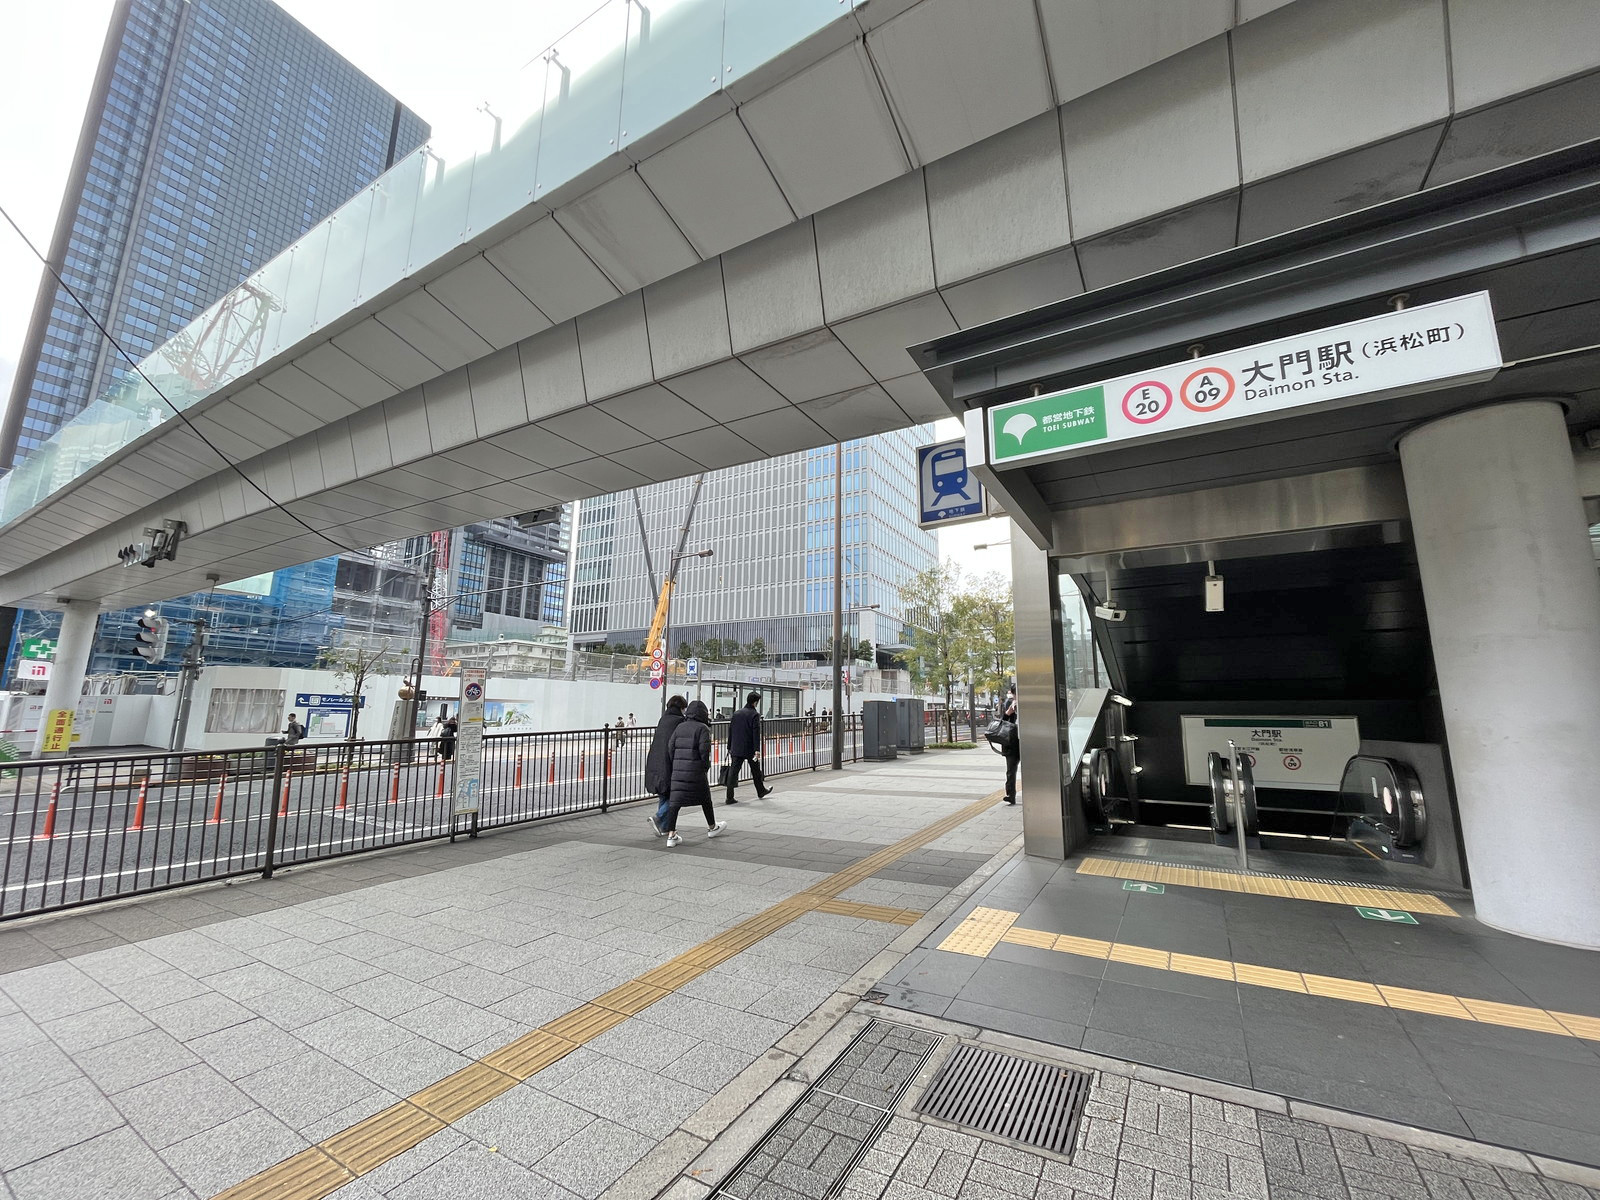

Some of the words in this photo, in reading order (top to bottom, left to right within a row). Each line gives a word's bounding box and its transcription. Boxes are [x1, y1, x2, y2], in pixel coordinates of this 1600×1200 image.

[1241, 341, 1355, 387] 大門駅
[1200, 375, 1213, 388] A
[1244, 379, 1316, 400] Daimon
[1322, 370, 1360, 386] Sta.
[1141, 388, 1150, 400] E
[1194, 387, 1220, 403] 09
[1042, 406, 1095, 425] 都営地下鉄
[1135, 400, 1160, 416] 20
[1042, 424, 1060, 433] TOEI
[1062, 416, 1095, 429] SUBWAY
[1318, 720, 1329, 728] B1
[1251, 729, 1282, 738] 大門駅
